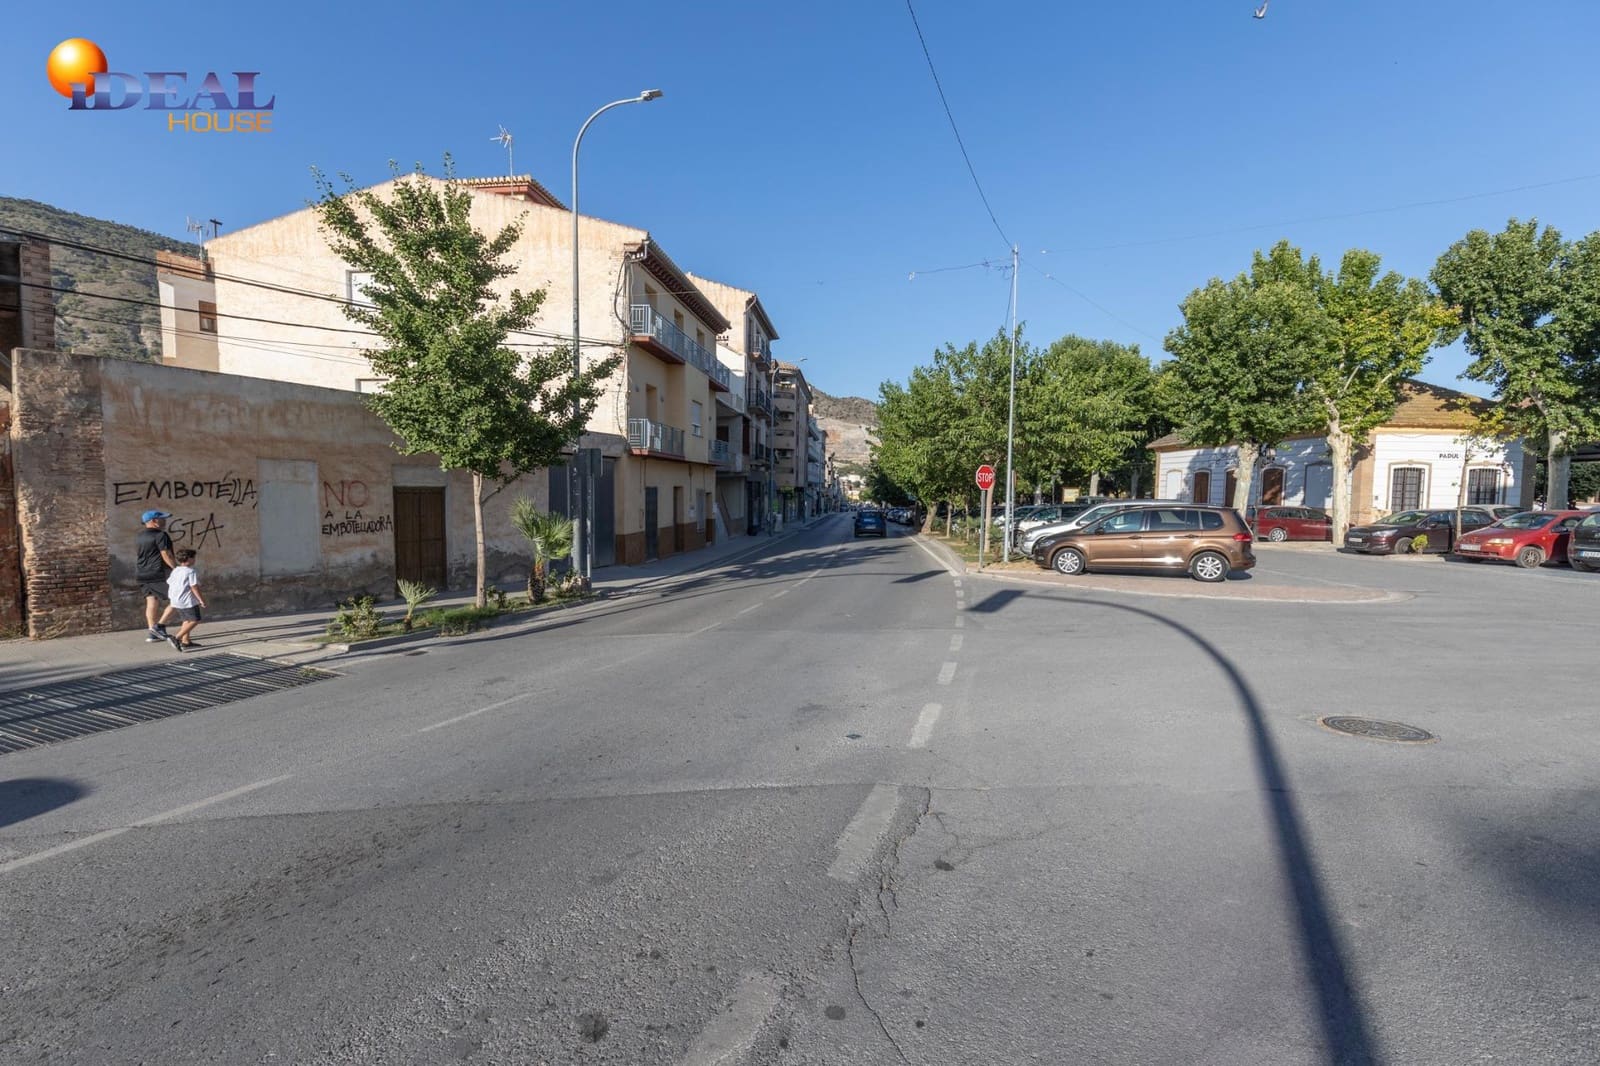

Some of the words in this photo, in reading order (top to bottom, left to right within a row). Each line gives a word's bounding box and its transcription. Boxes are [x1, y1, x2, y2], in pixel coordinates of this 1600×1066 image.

[978, 472, 993, 482] STOP
[323, 479, 370, 508] NO
[321, 514, 393, 536] EMBOTELLADORA
[324, 510, 334, 519] A
[345, 510, 363, 520] LA
[168, 512, 224, 549] STA
